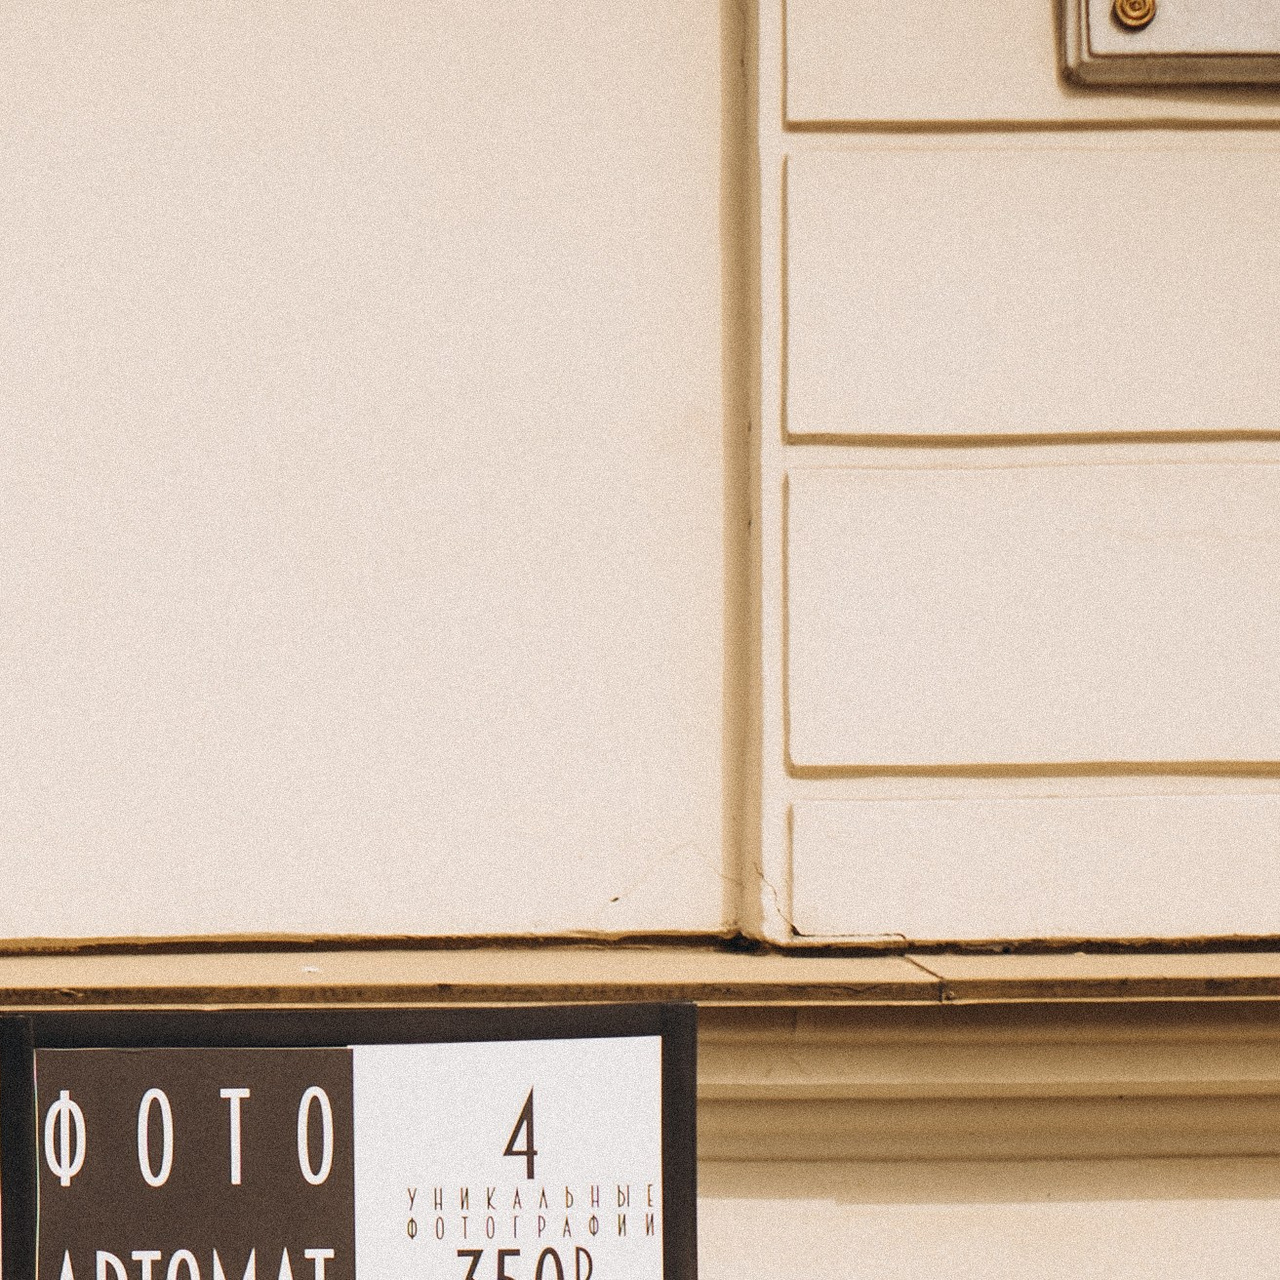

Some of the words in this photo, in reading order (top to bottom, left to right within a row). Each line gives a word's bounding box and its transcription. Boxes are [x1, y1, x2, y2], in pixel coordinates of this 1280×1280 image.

[44, 1086, 334, 1187] ФОТО
[502, 1086, 538, 1180] 4
[406, 1213, 655, 1240] ФОТОГРАФИИ
[407, 1183, 654, 1211] УНИКАЛЬНЫЕ
